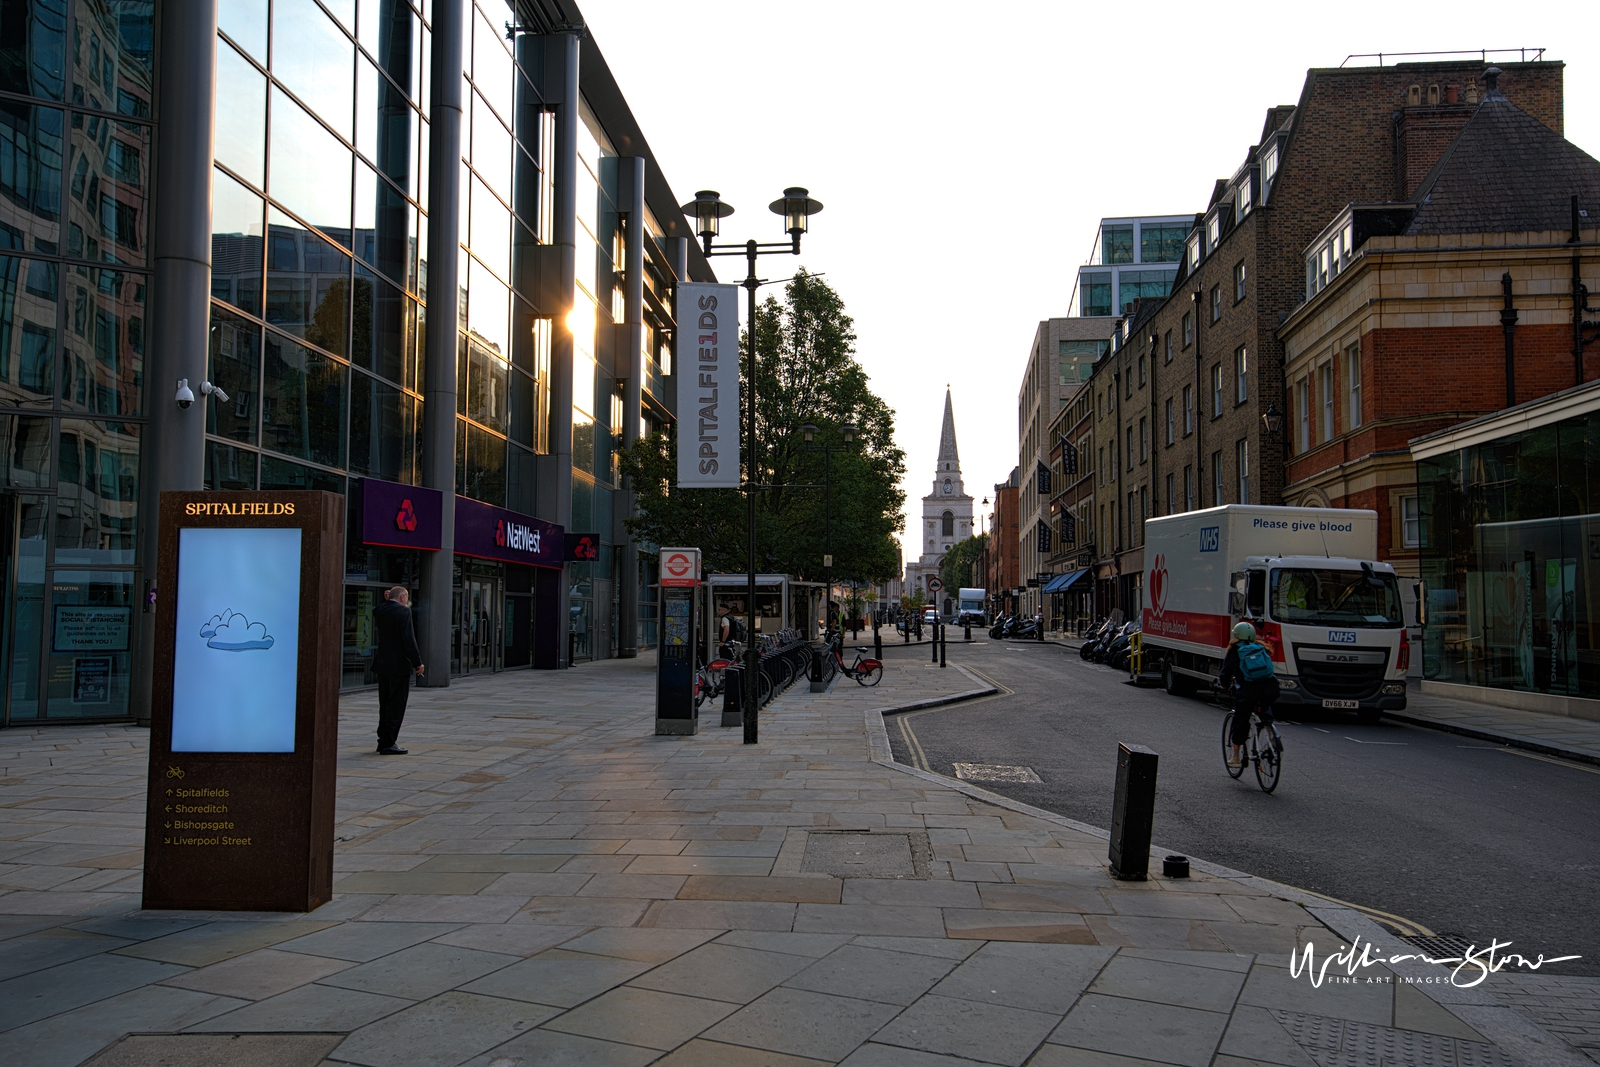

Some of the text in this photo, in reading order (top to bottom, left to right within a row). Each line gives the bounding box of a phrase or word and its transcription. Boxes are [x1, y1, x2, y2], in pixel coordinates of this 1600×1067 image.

[185, 502, 295, 515] SPITALFIELDS
[1253, 518, 1352, 532] Please give blood
[507, 521, 541, 554] NatWest
[1200, 528, 1219, 550] NHS
[1148, 616, 1161, 631] Please
[1172, 619, 1187, 635] blood
[1329, 632, 1355, 642] NHS
[1326, 654, 1359, 662] DAF
[175, 788, 230, 798] Spitalfields
[175, 804, 228, 814] Shoreditch
[174, 820, 235, 831] Bishopsgate
[173, 836, 252, 846] Liverpool Street
